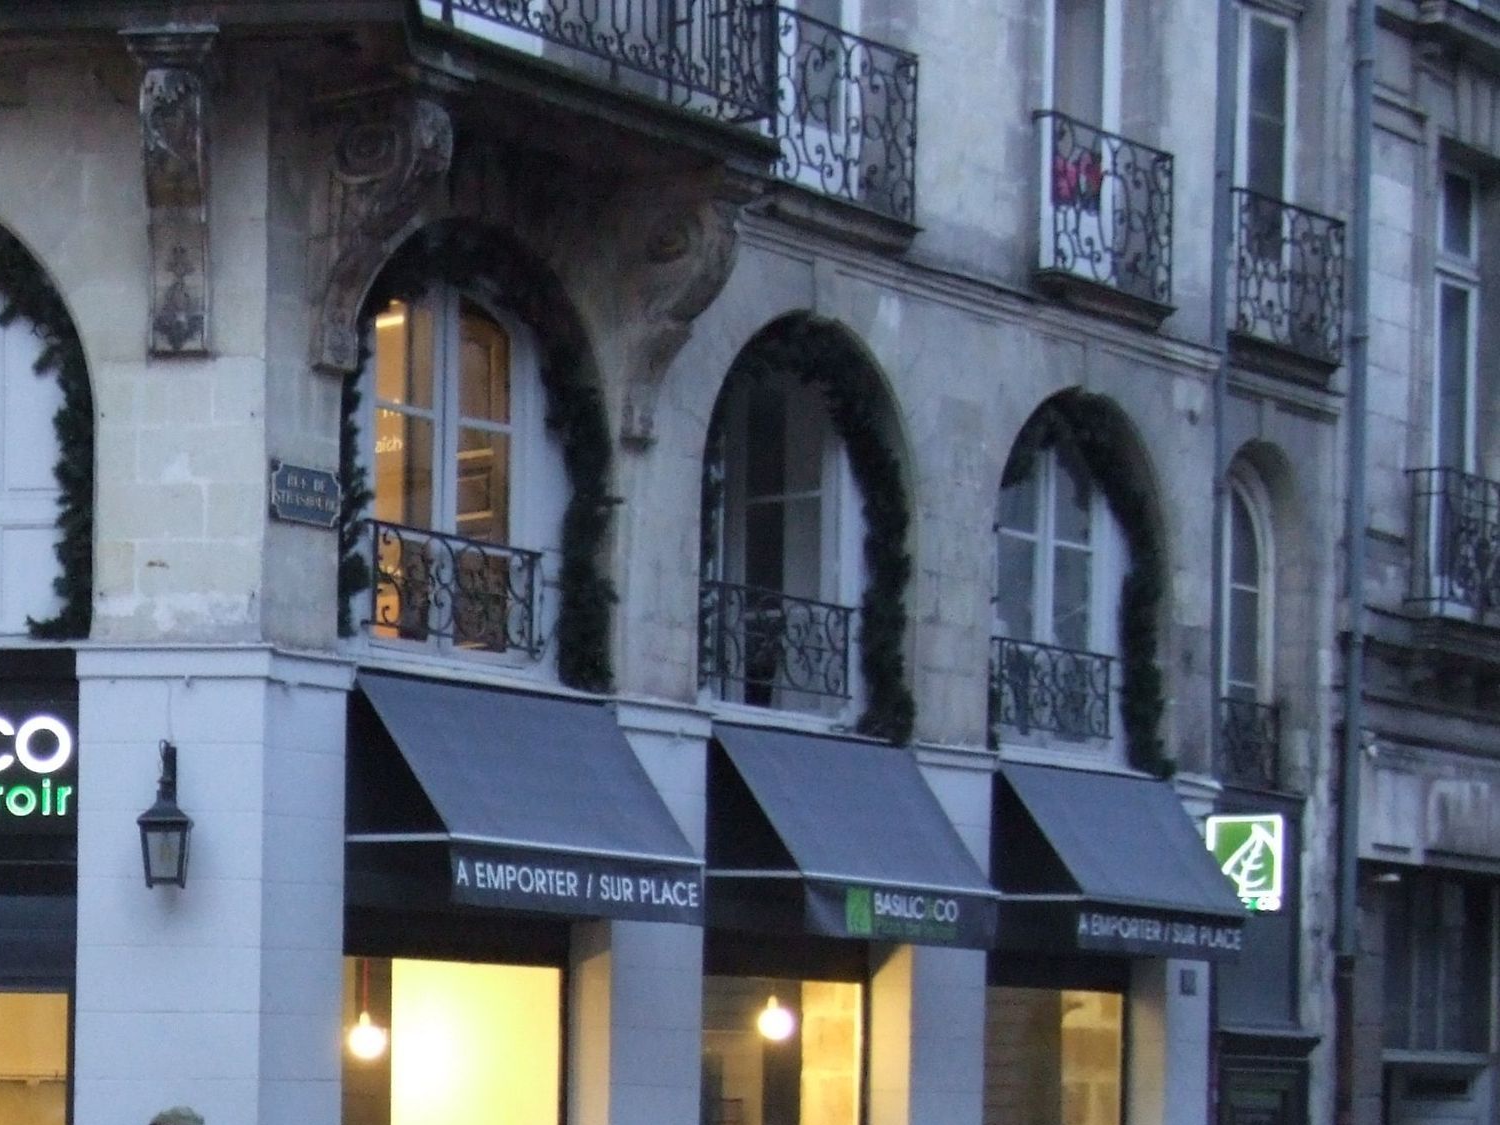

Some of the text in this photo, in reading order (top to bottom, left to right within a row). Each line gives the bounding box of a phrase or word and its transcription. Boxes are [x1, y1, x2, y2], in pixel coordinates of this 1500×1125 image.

[456, 859, 469, 886] A
[475, 862, 579, 897] EMPORTER
[600, 875, 634, 902] SUR
[640, 878, 699, 908] PLACE
